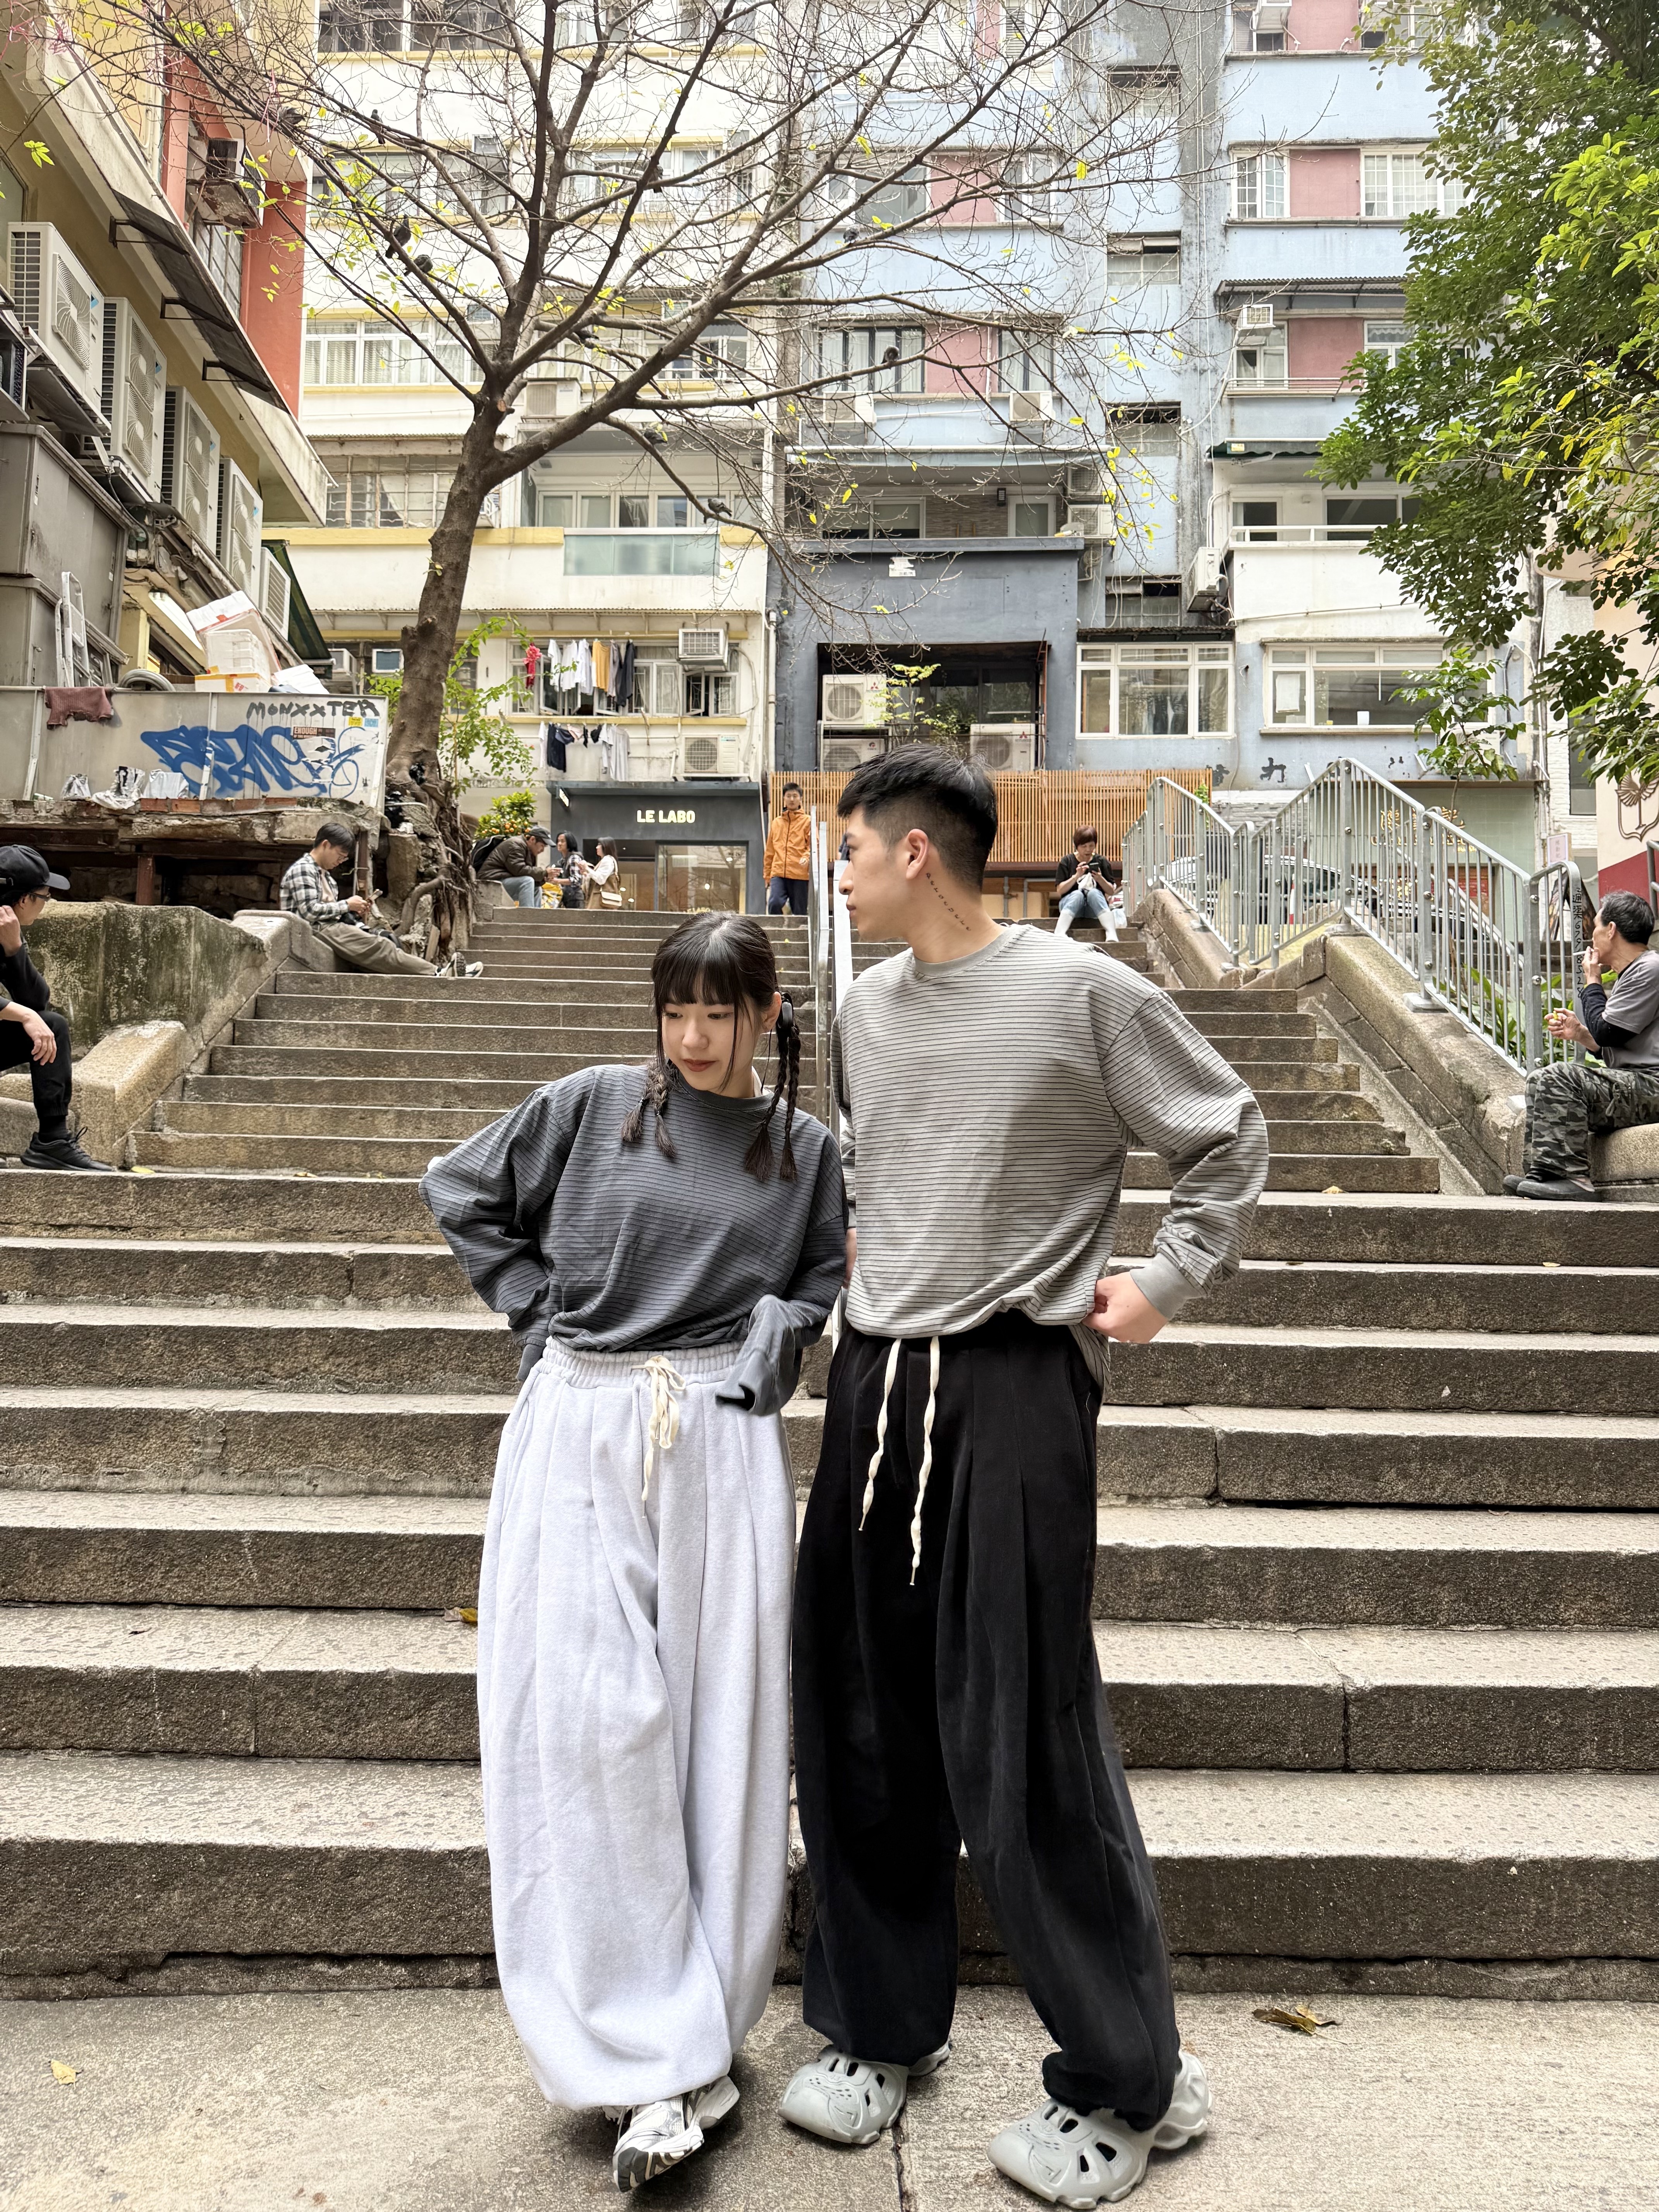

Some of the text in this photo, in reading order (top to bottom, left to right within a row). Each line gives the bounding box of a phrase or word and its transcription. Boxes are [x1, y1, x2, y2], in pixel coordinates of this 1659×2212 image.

[246, 699, 380, 719] MONXXTER
[637, 810, 695, 823] LE LABO
